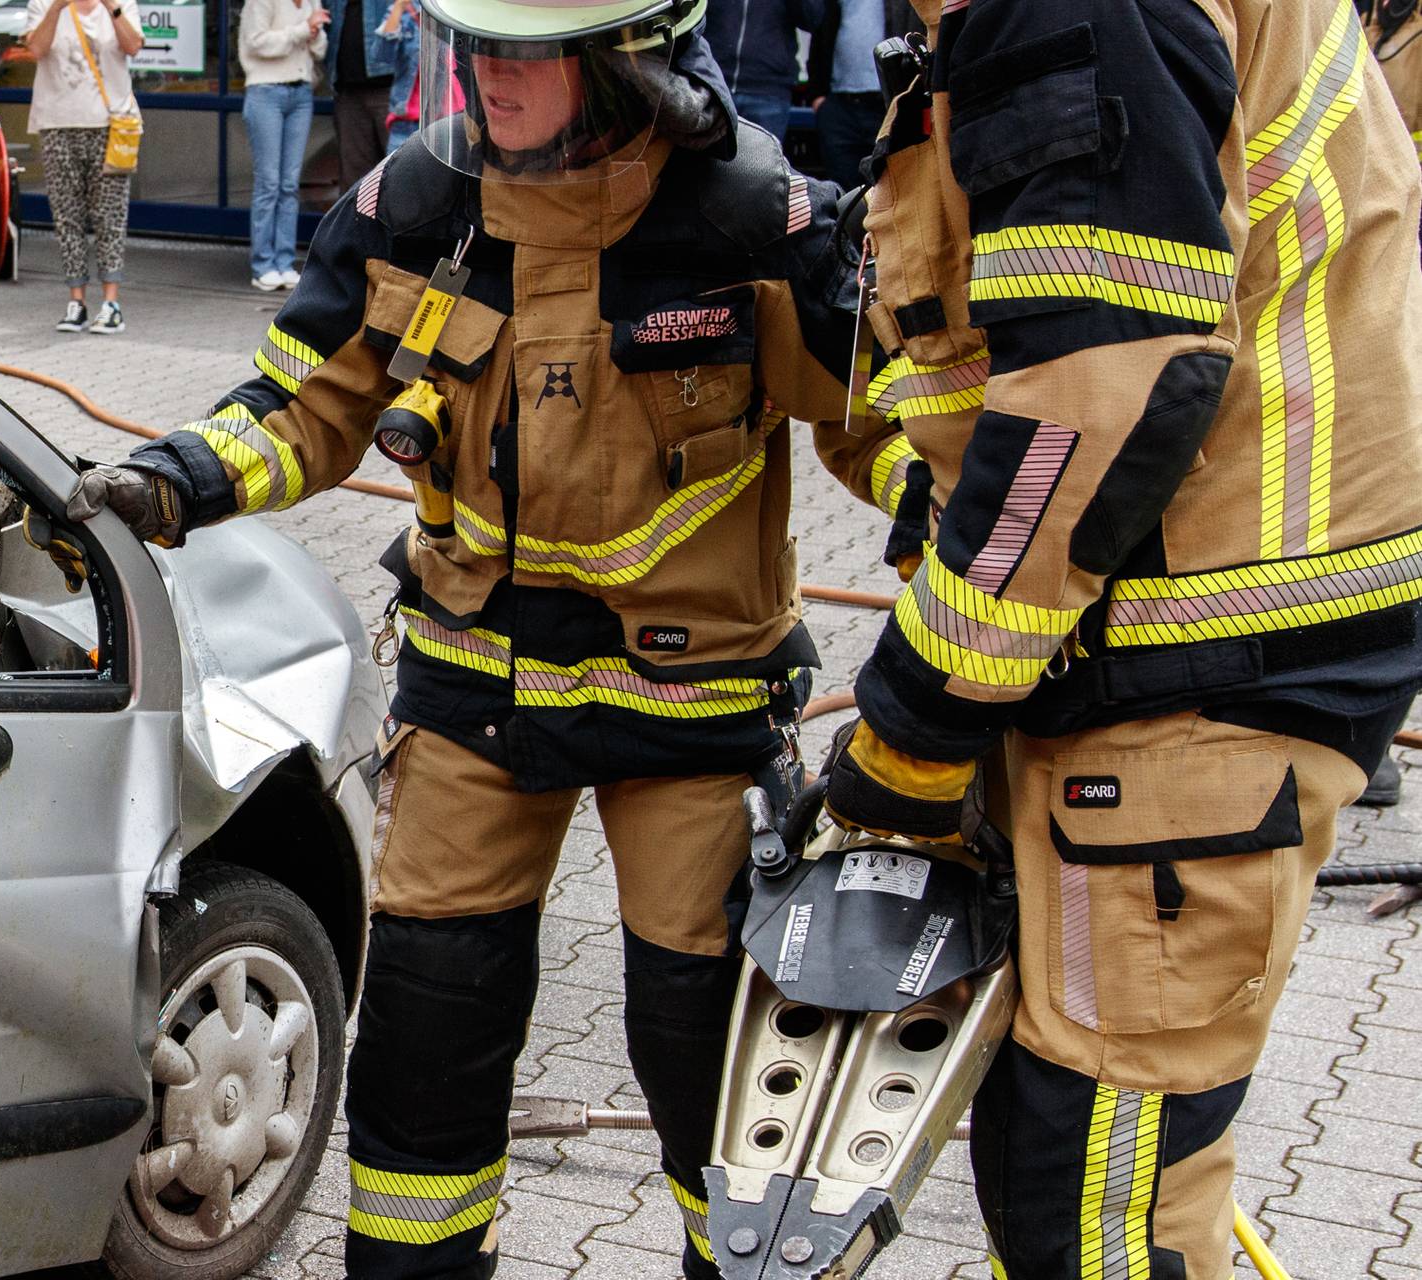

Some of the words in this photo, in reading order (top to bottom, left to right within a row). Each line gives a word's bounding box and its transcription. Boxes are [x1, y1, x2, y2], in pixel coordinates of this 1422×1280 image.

[661, 323, 706, 342] ESSEN
[641, 631, 686, 645] S-GARD
[1067, 784, 1117, 800] S-GARD
